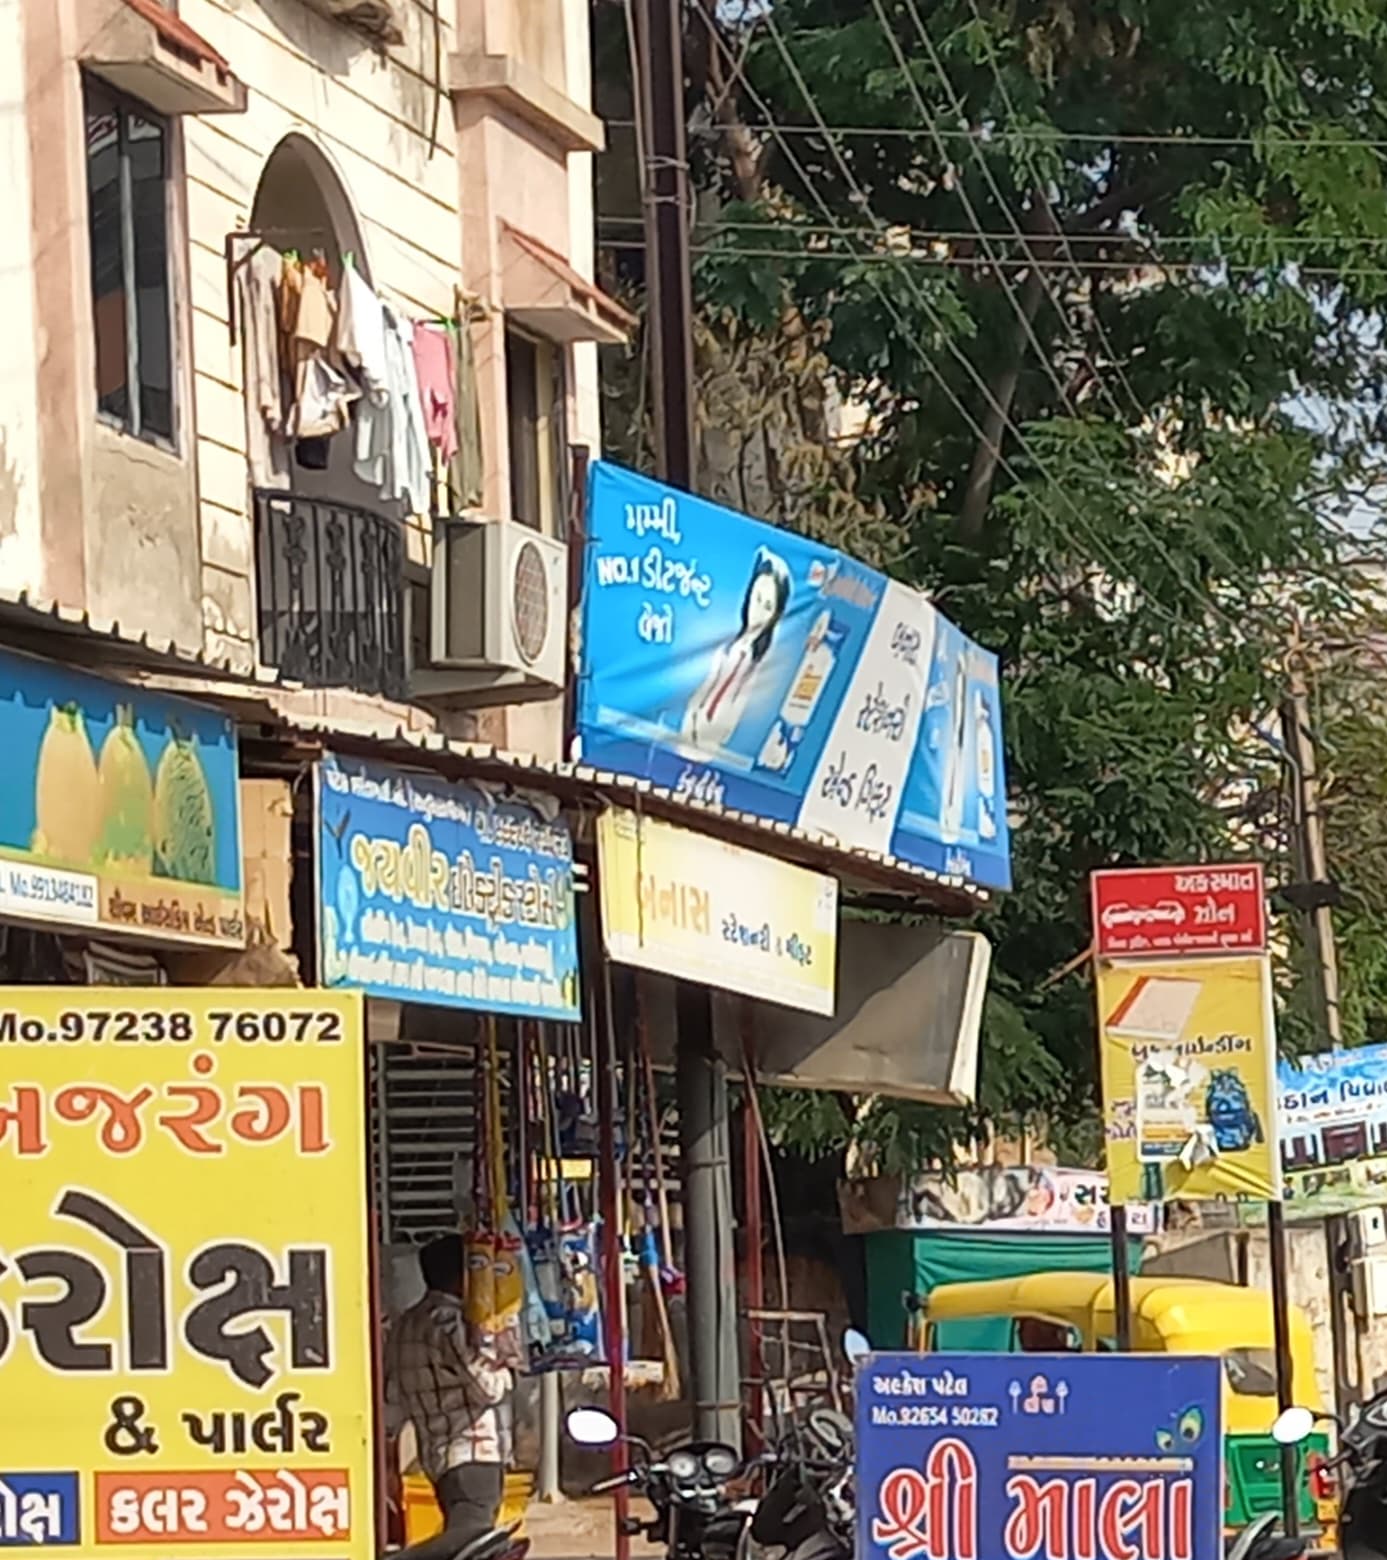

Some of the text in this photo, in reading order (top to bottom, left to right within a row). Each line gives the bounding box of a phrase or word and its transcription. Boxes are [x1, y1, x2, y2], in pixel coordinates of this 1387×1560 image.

[207, 1011, 342, 1042] 76072
[0, 1189, 332, 1391] રોક્ષ
[104, 1392, 332, 1456] & પાર્લર
[109, 1484, 208, 1534] કલર
[224, 1469, 350, 1537] ઝેરોક્ષ
